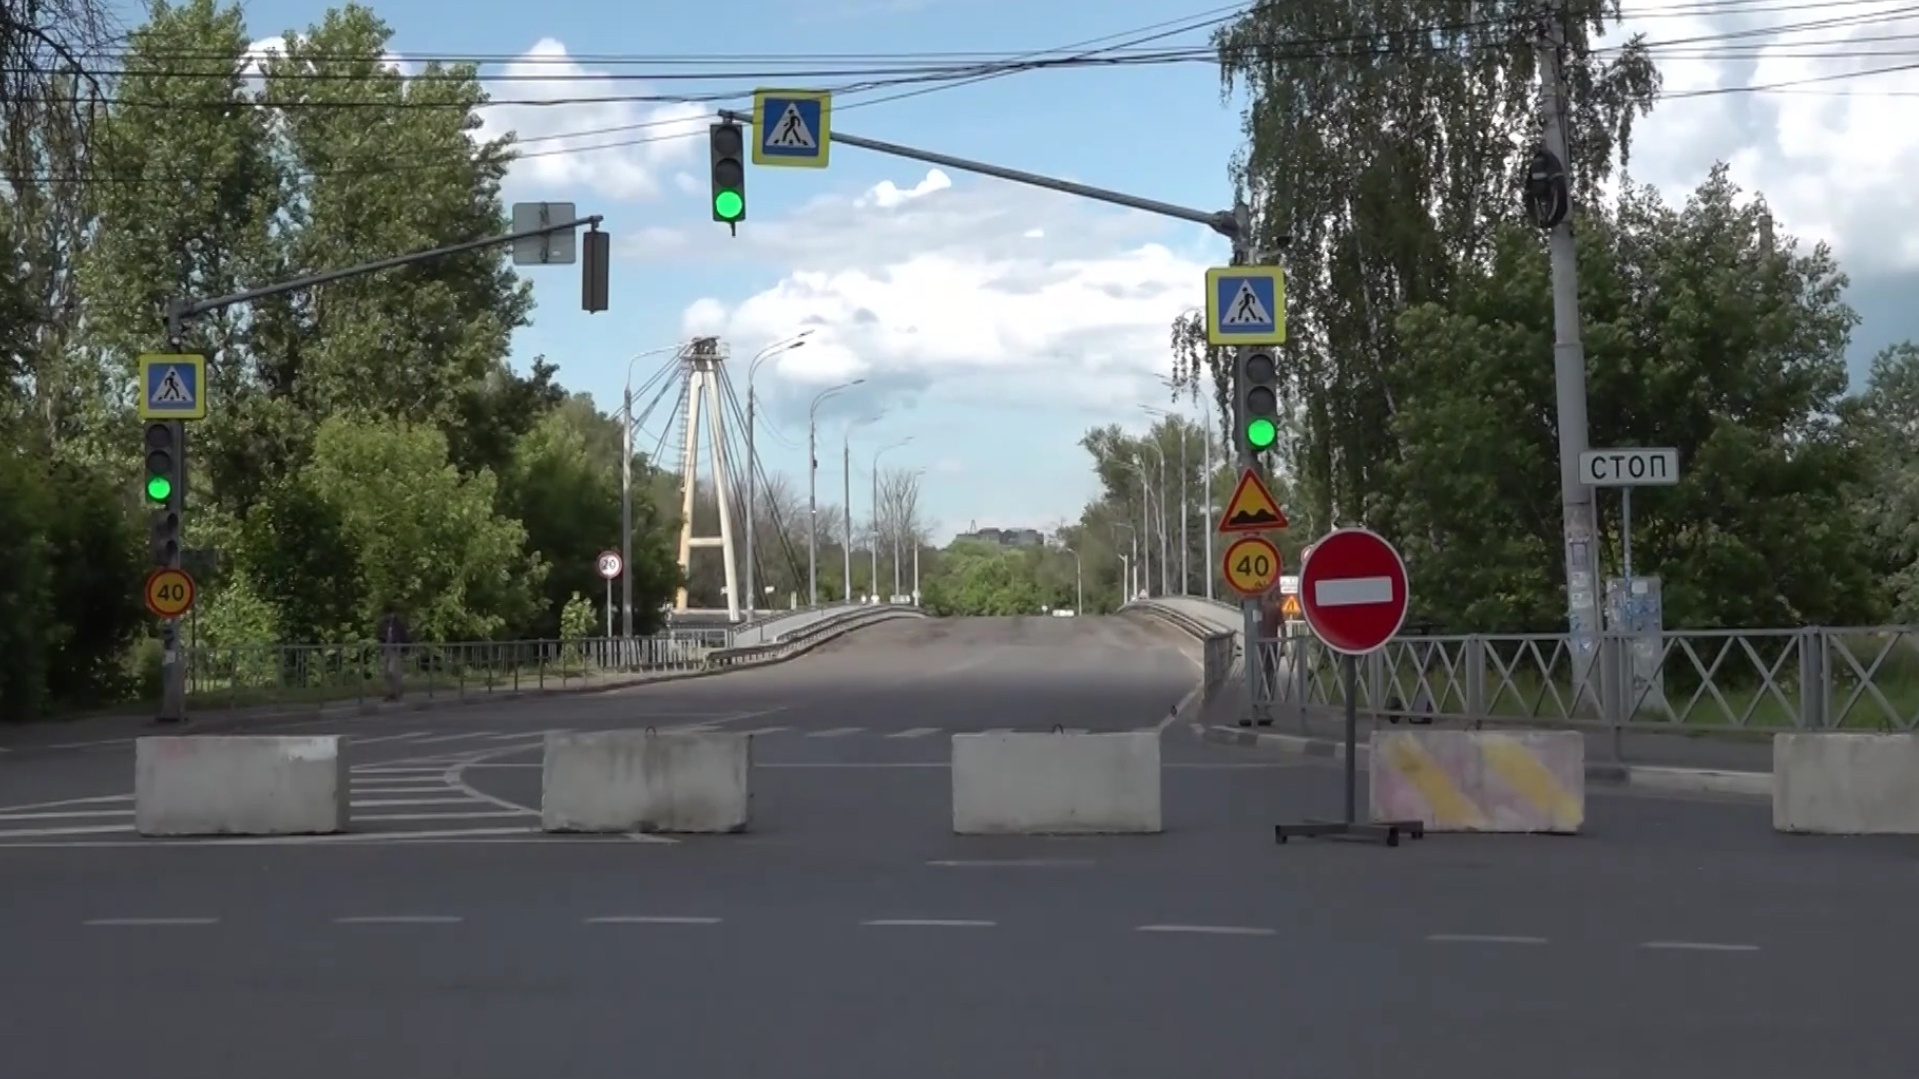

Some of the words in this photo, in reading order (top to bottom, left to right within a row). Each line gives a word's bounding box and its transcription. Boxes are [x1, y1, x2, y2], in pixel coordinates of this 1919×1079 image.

[1591, 455, 1666, 479] СТОП
[1236, 555, 1269, 577] 40
[157, 584, 184, 602] 40
